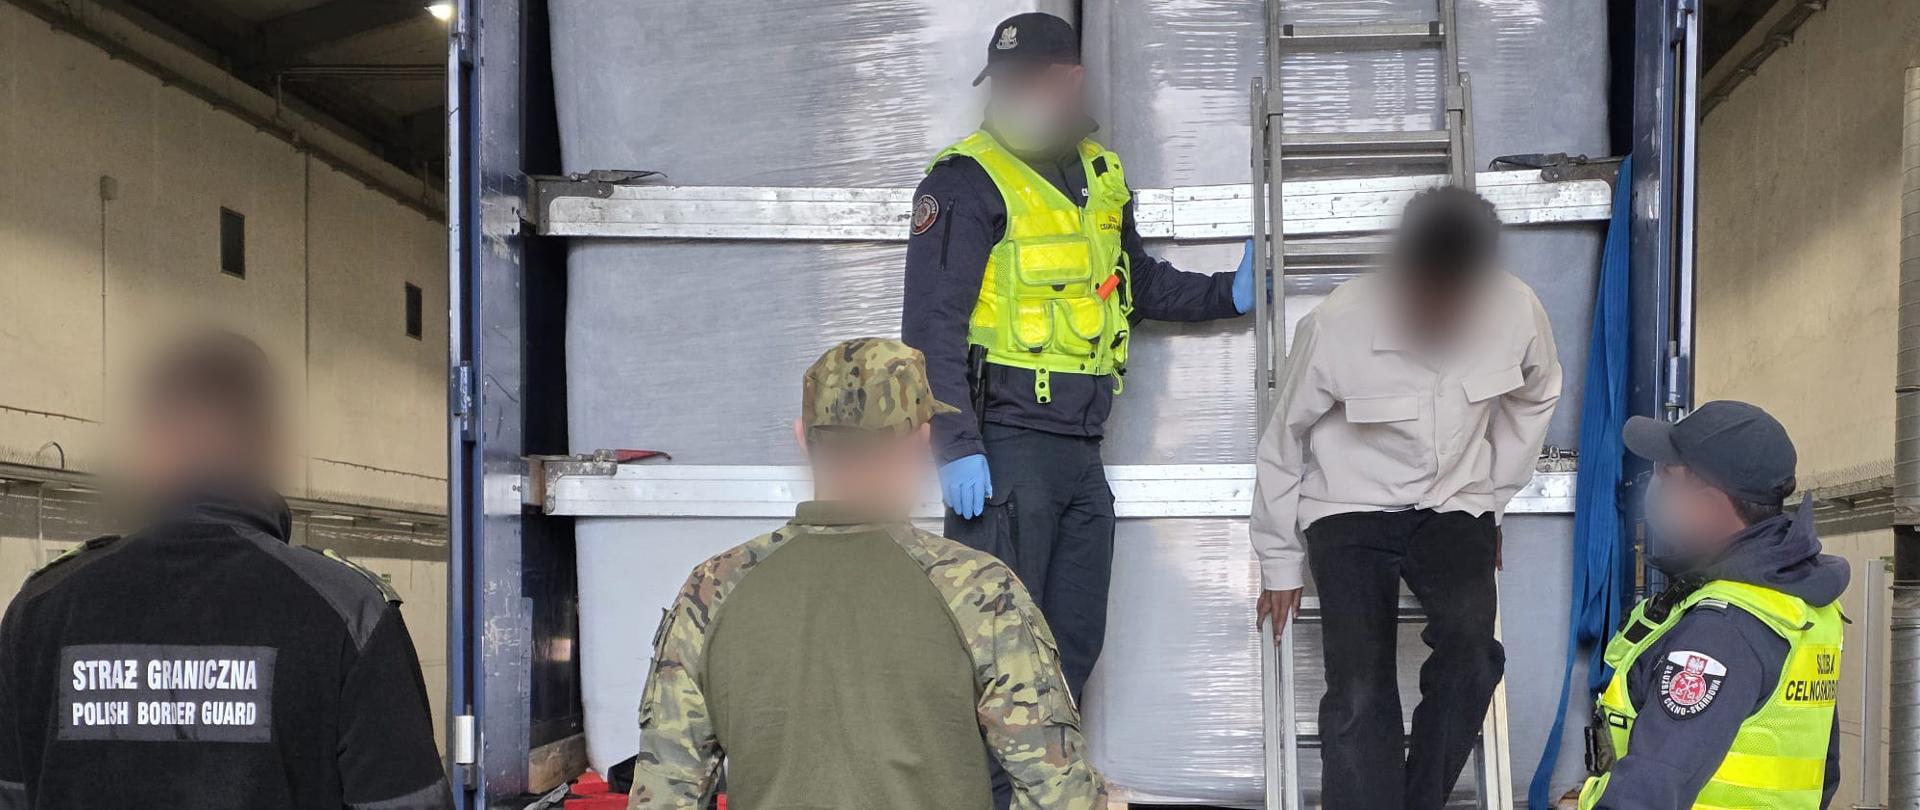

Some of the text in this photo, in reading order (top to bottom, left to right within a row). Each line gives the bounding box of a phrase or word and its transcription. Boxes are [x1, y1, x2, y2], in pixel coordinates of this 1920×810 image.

[147, 659, 257, 690] GRANICZNA
[1663, 679, 1721, 716] CELNO-SKARBOWA
[72, 701, 257, 726] POLISH BORDER GUARD
